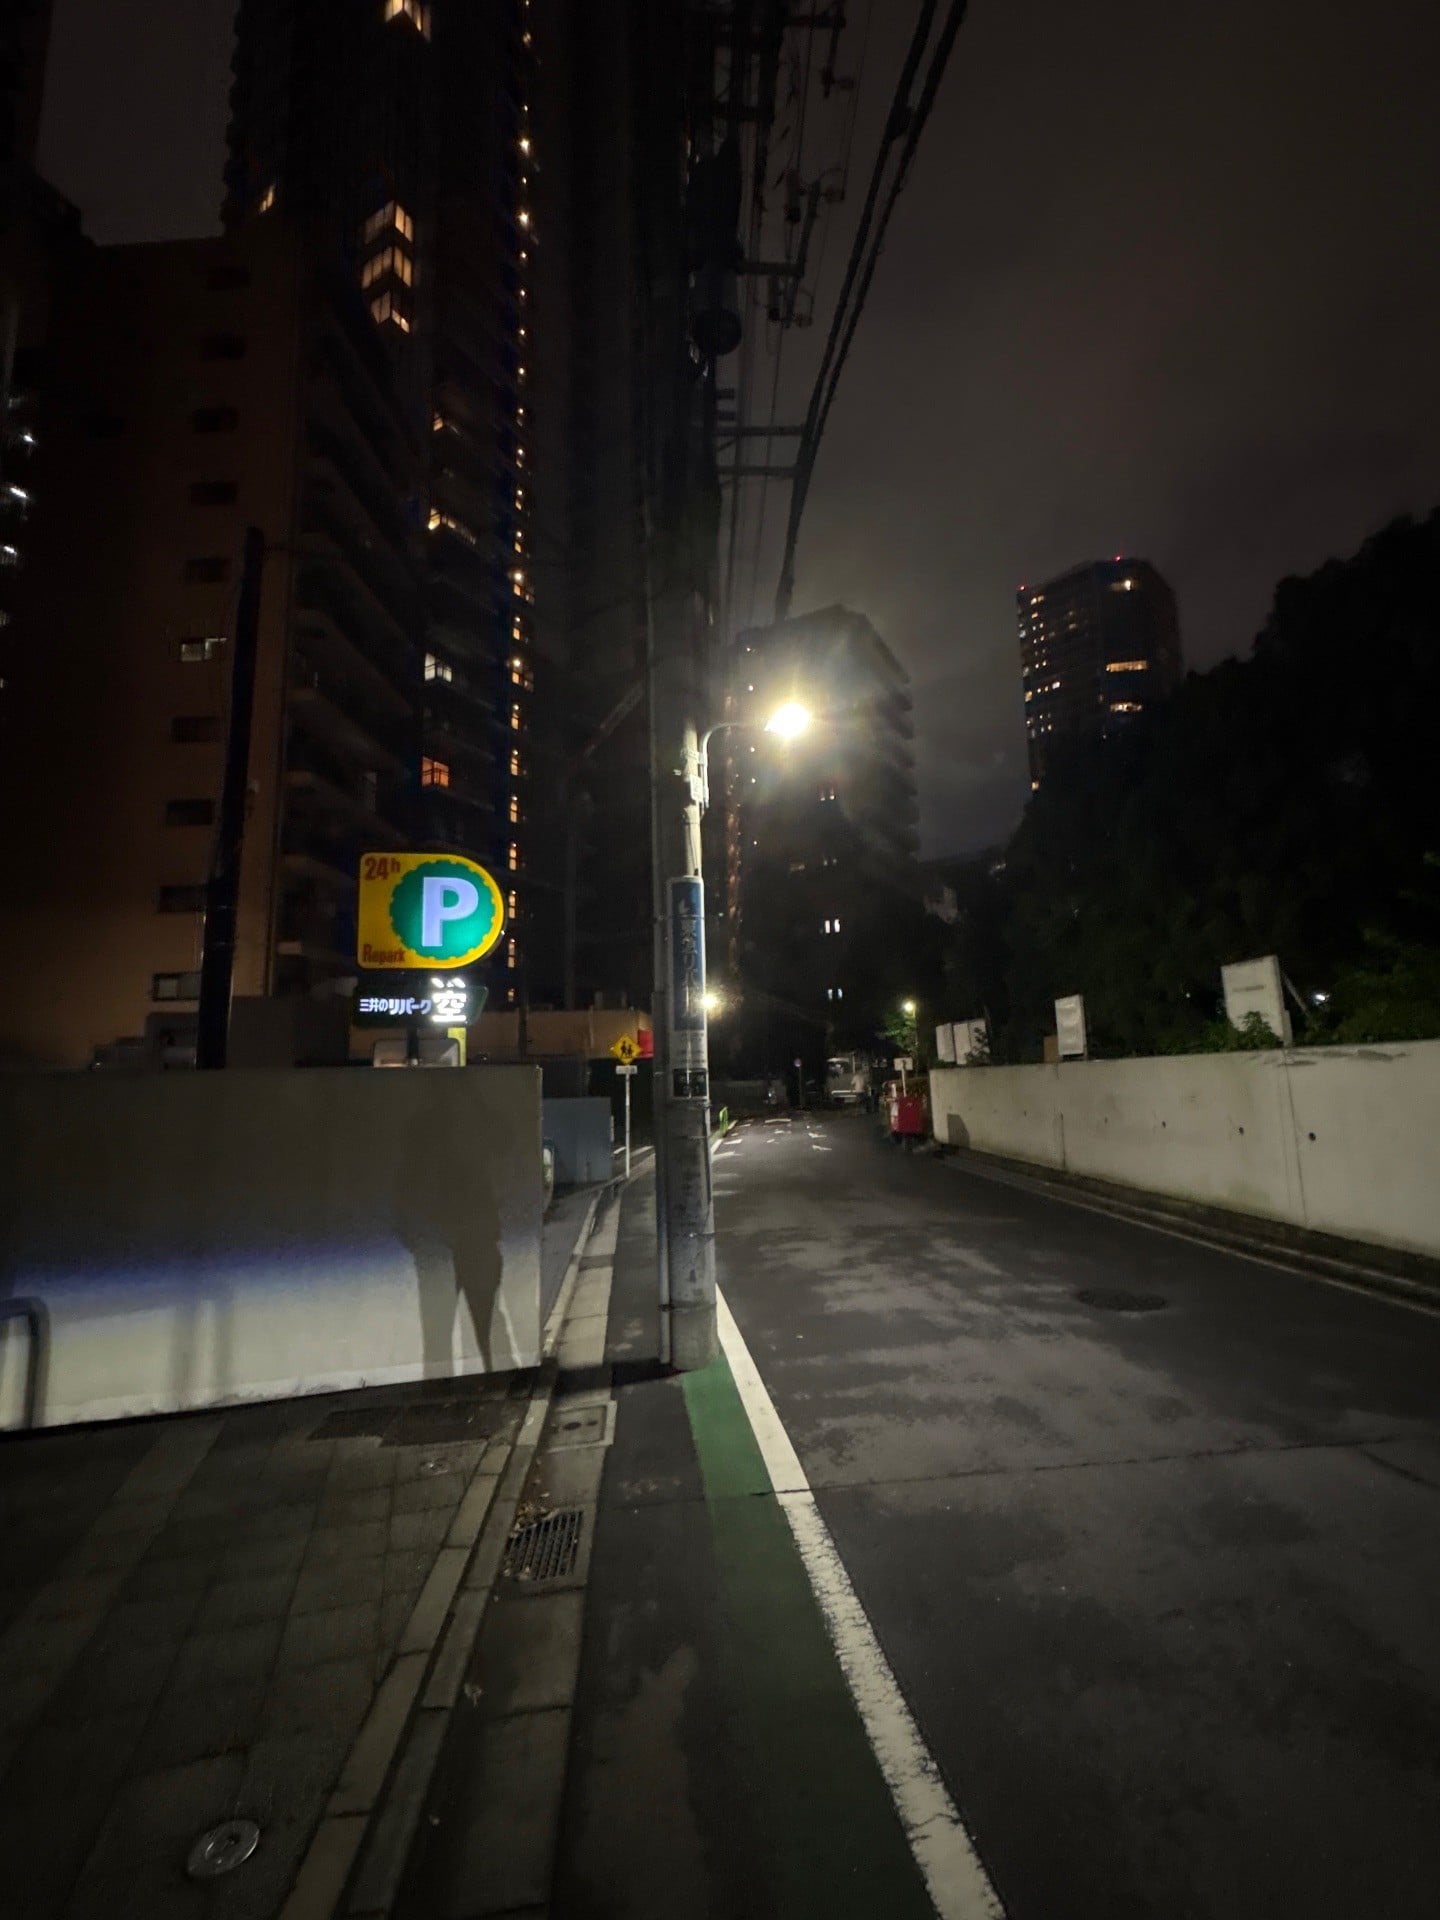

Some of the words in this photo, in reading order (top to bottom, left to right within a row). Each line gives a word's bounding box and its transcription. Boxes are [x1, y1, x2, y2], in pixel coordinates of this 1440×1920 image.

[364, 856, 401, 882] 24h
[421, 876, 479, 947] P
[362, 943, 406, 965] Repark
[359, 997, 432, 1016] 三井のリパーク
[431, 989, 467, 1023] 空
